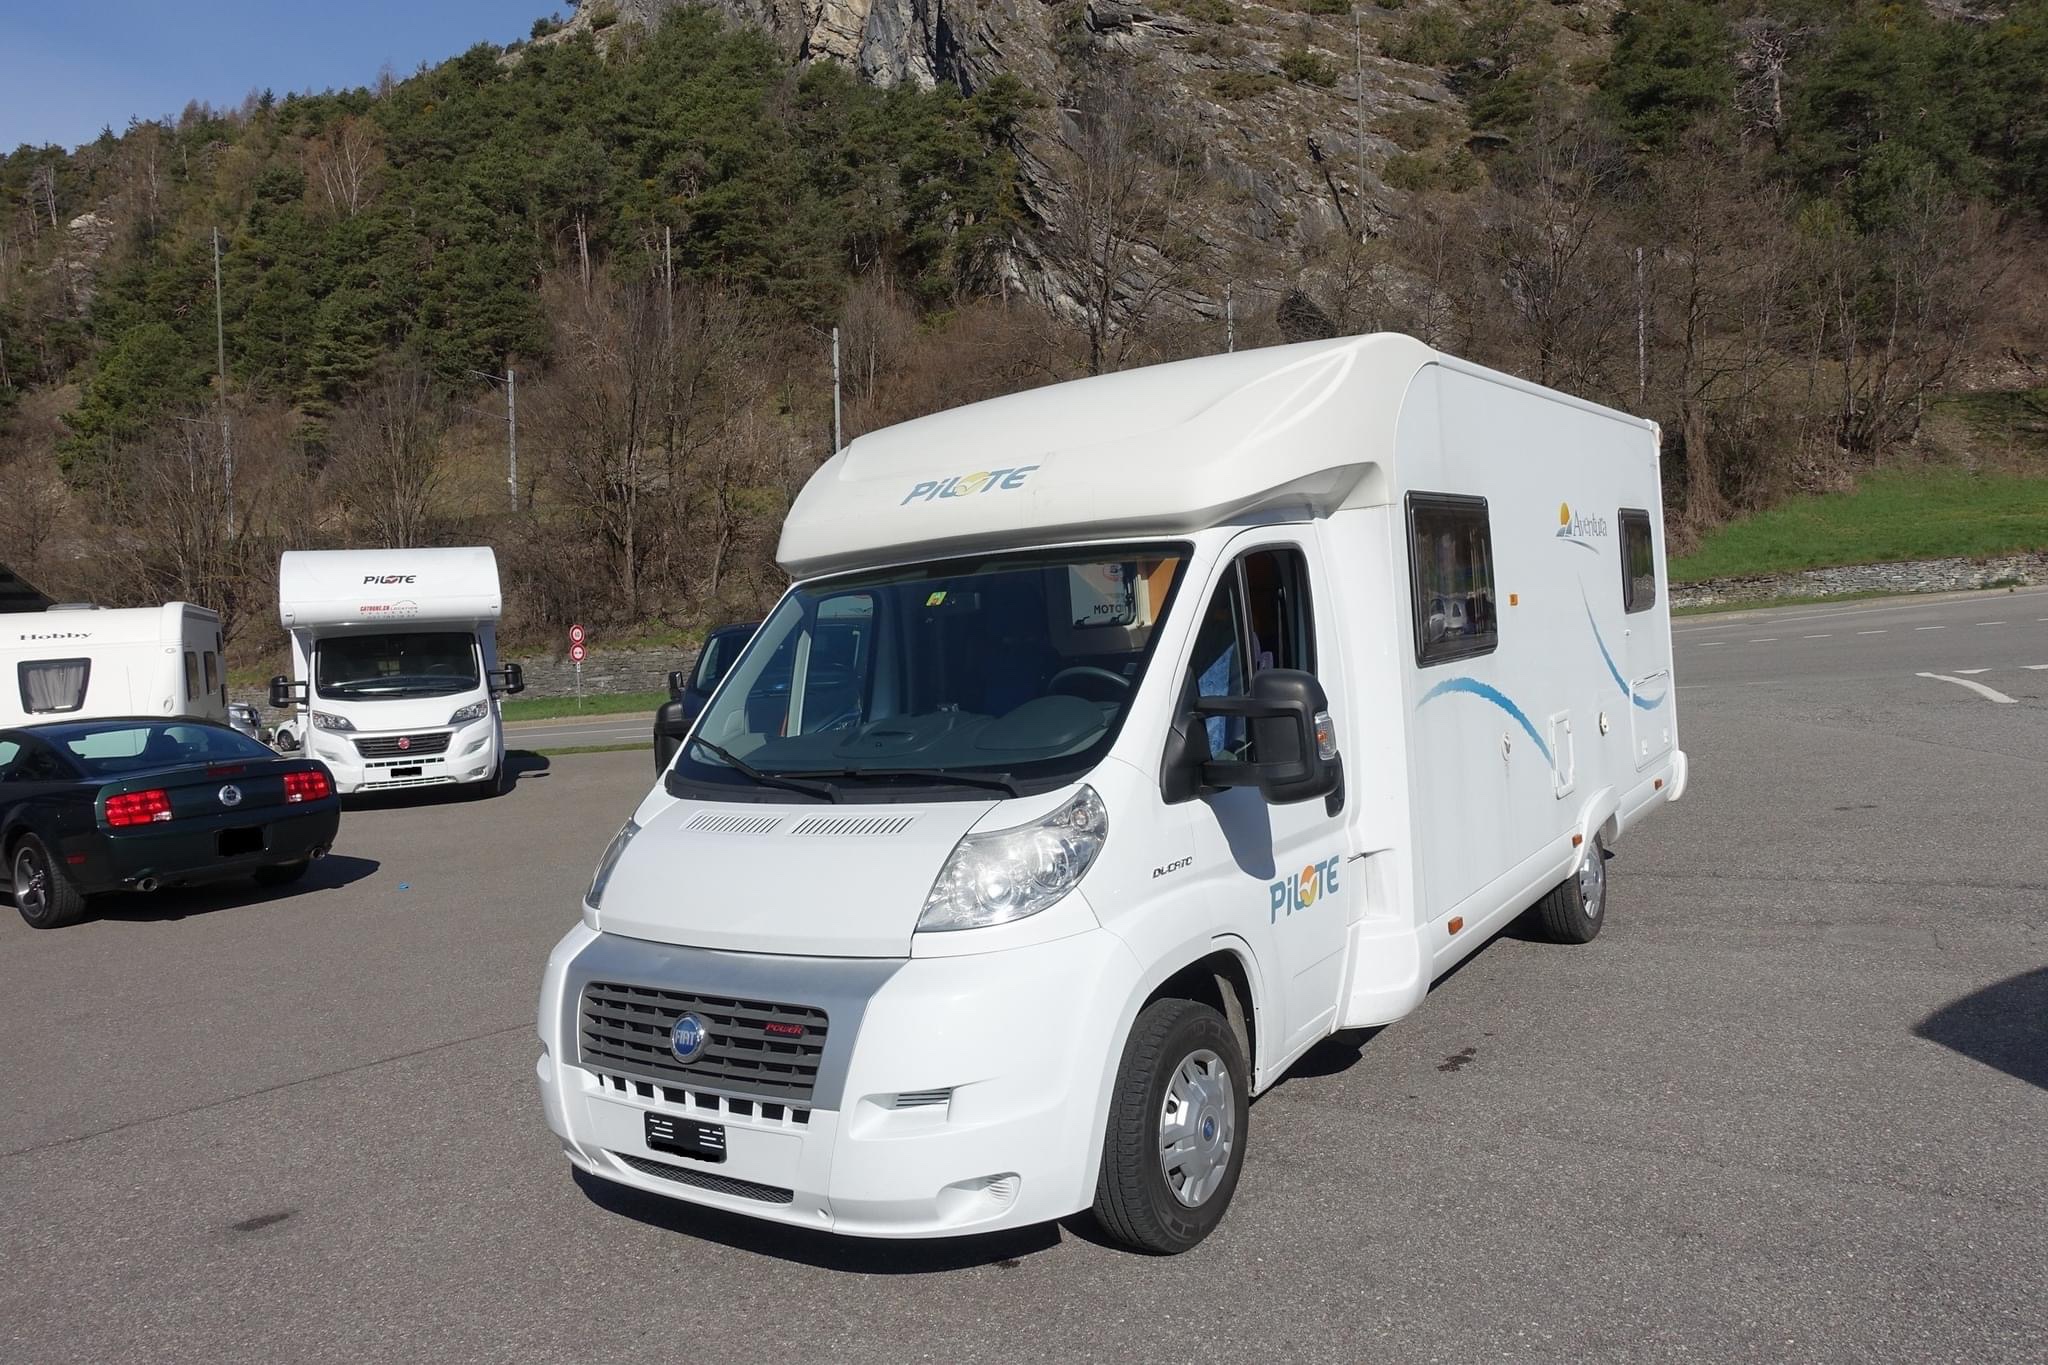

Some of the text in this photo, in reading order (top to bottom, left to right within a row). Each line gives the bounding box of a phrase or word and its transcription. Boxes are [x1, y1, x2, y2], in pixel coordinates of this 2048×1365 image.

[20, 632, 92, 641] Hobby
[1152, 856, 1193, 879] DUCATO
[765, 1022, 803, 1035] POWER
[675, 1029, 698, 1046] FIAT
